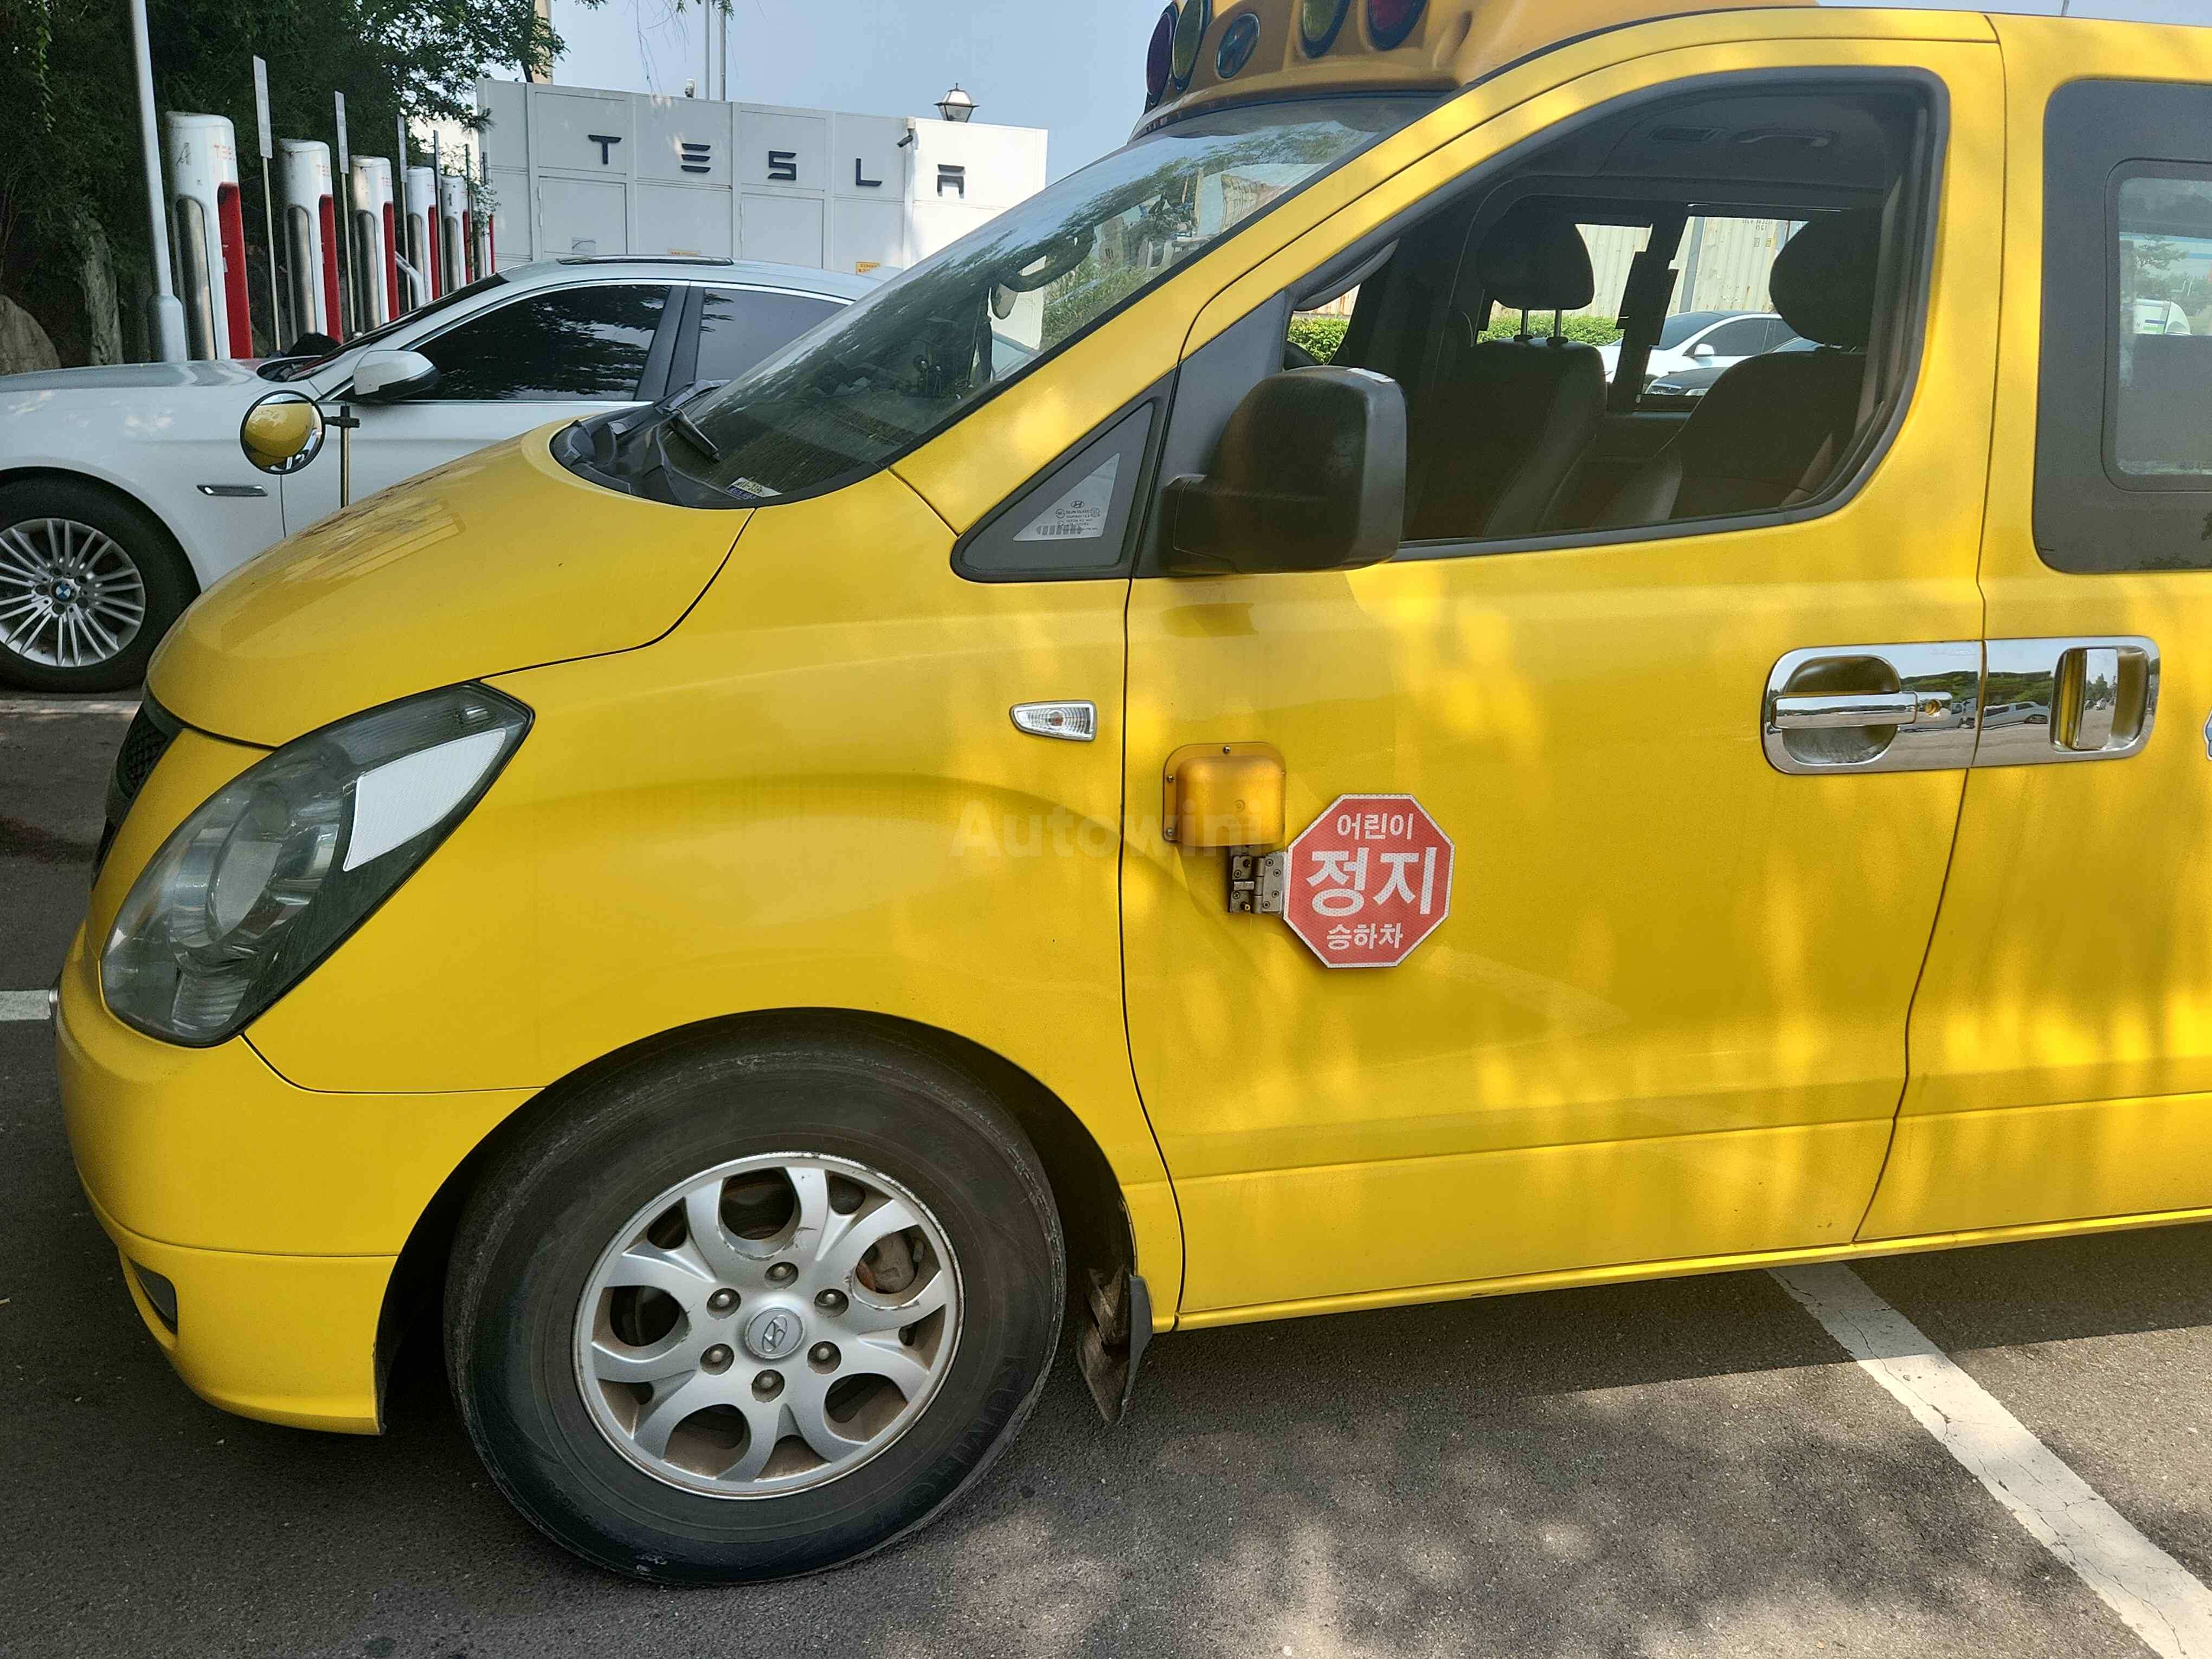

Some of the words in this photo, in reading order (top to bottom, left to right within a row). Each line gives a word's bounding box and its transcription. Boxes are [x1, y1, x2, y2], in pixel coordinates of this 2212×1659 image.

[588, 134, 965, 198] TESLA
[1336, 813, 1413, 841] 어린이
[1306, 846, 1438, 916] 정지
[1326, 922, 1403, 950] 승하차
